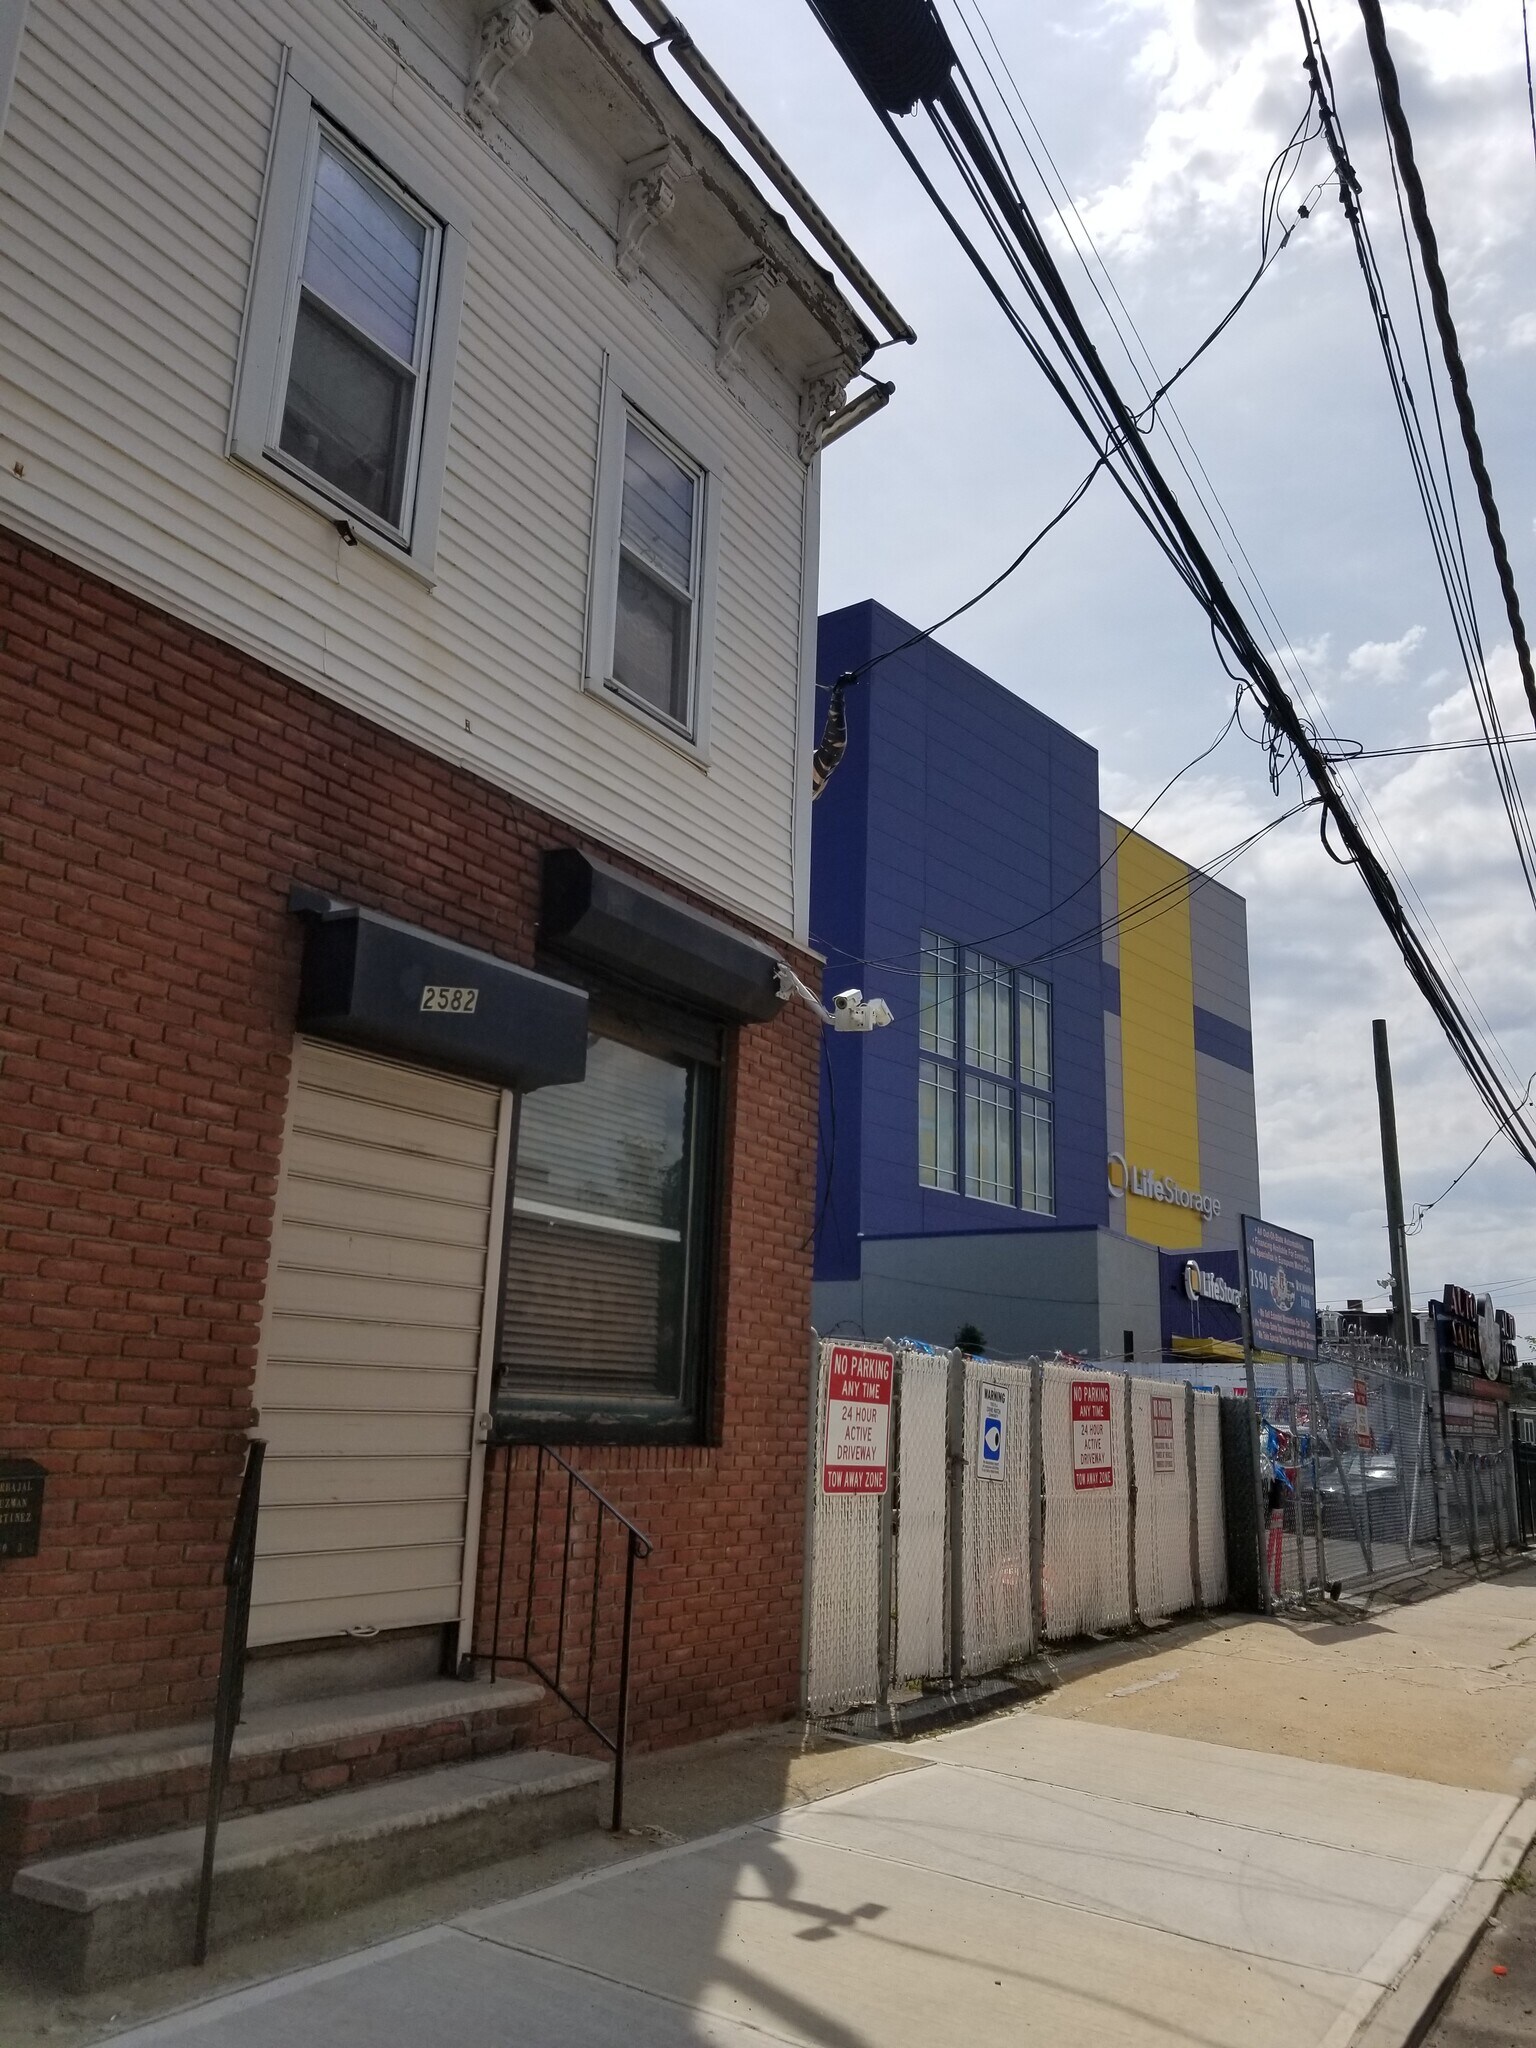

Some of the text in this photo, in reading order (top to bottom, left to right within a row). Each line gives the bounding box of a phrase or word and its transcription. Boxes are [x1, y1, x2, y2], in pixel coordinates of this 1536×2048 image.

[423, 988, 476, 1011] 2582
[1130, 1165, 1221, 1221] LifeStorage
[1201, 1271, 1241, 1313] LifeStora
[834, 1354, 889, 1380] NO PARKING
[842, 1380, 880, 1399] ANY TIME
[984, 1388, 1006, 1404] WARNING
[1073, 1386, 1108, 1402] NO PARKING
[842, 1406, 877, 1423] 24 HOUR
[1080, 1406, 1104, 1417] ANY TIME
[845, 1426, 872, 1441] ACTIVE
[1081, 1424, 1103, 1435] 24 HOUR
[837, 1445, 877, 1460] DRIVEWAY
[1084, 1439, 1101, 1450] ACTIVE
[1080, 1453, 1105, 1465] DRIVEWAY
[828, 1471, 883, 1487] TOW AWAY ZONE
[1076, 1472, 1111, 1485] TOW AWAY ZONE
